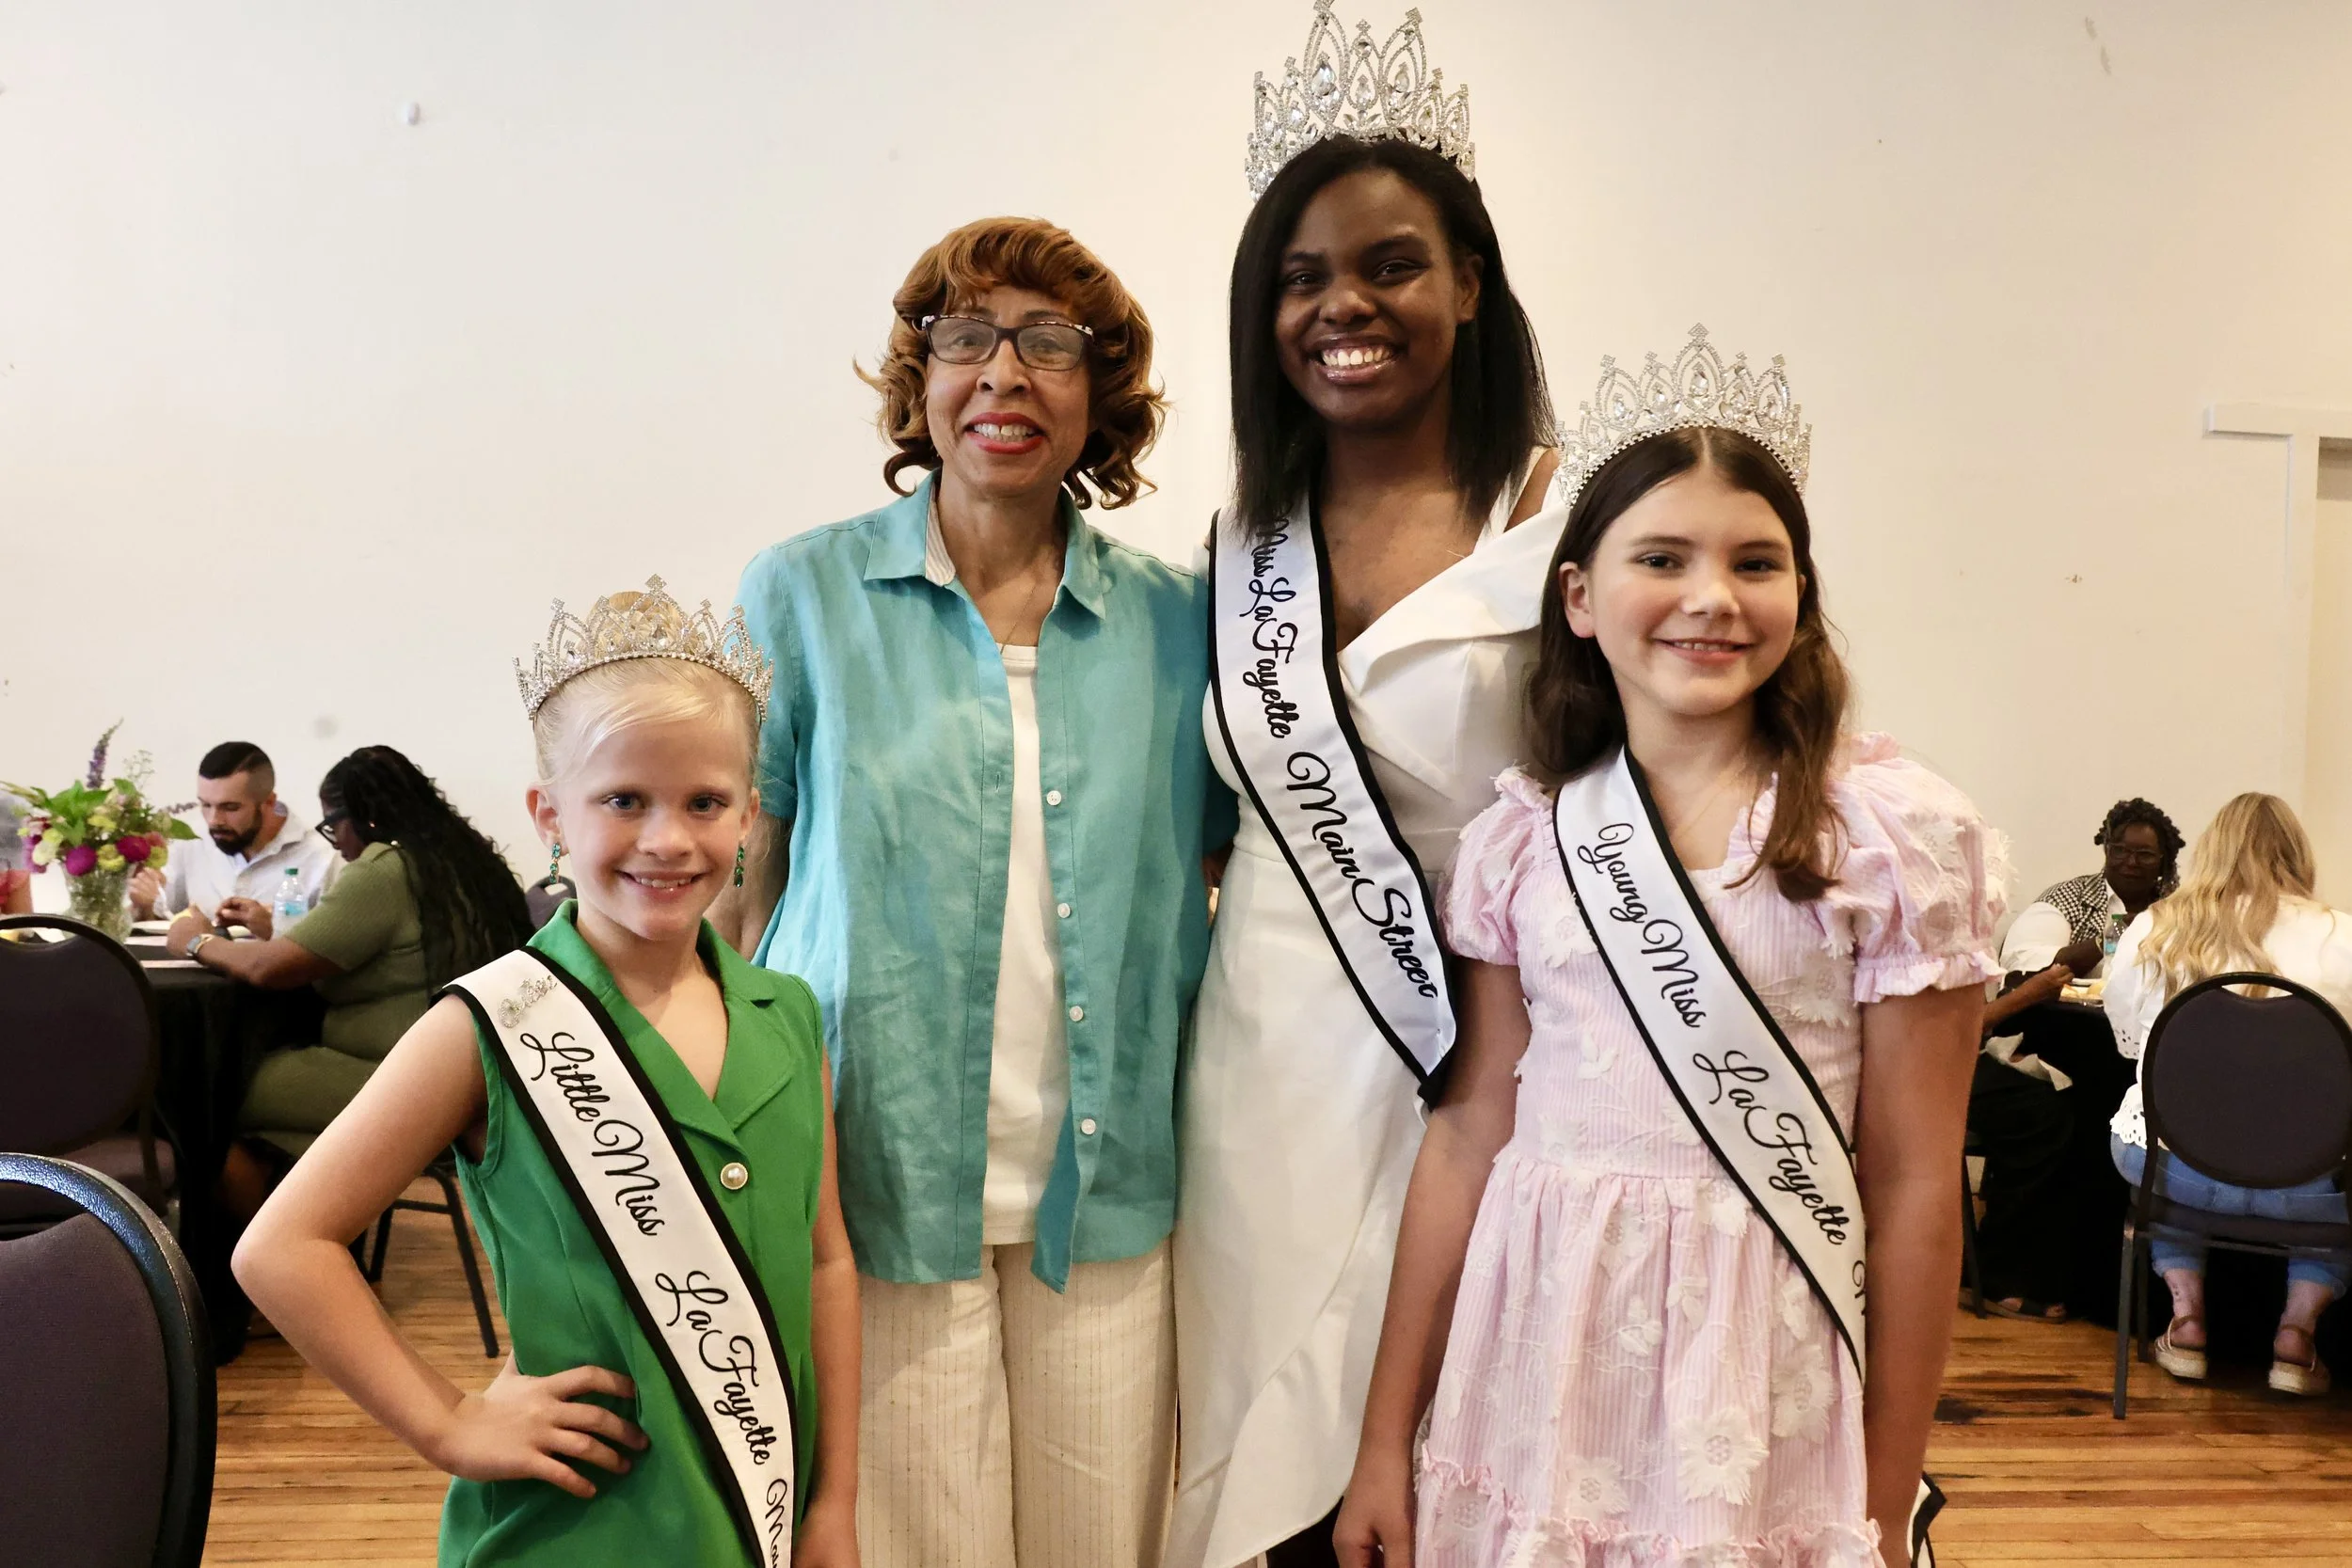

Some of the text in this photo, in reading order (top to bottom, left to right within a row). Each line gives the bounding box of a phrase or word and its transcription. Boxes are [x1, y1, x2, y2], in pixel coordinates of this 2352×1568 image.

[1286, 751, 1360, 880] Main
[1577, 822, 1647, 925] Young
[1641, 918, 1707, 1029] Miss
[519, 1031, 611, 1123] Little
[591, 1118, 665, 1236] Miss
